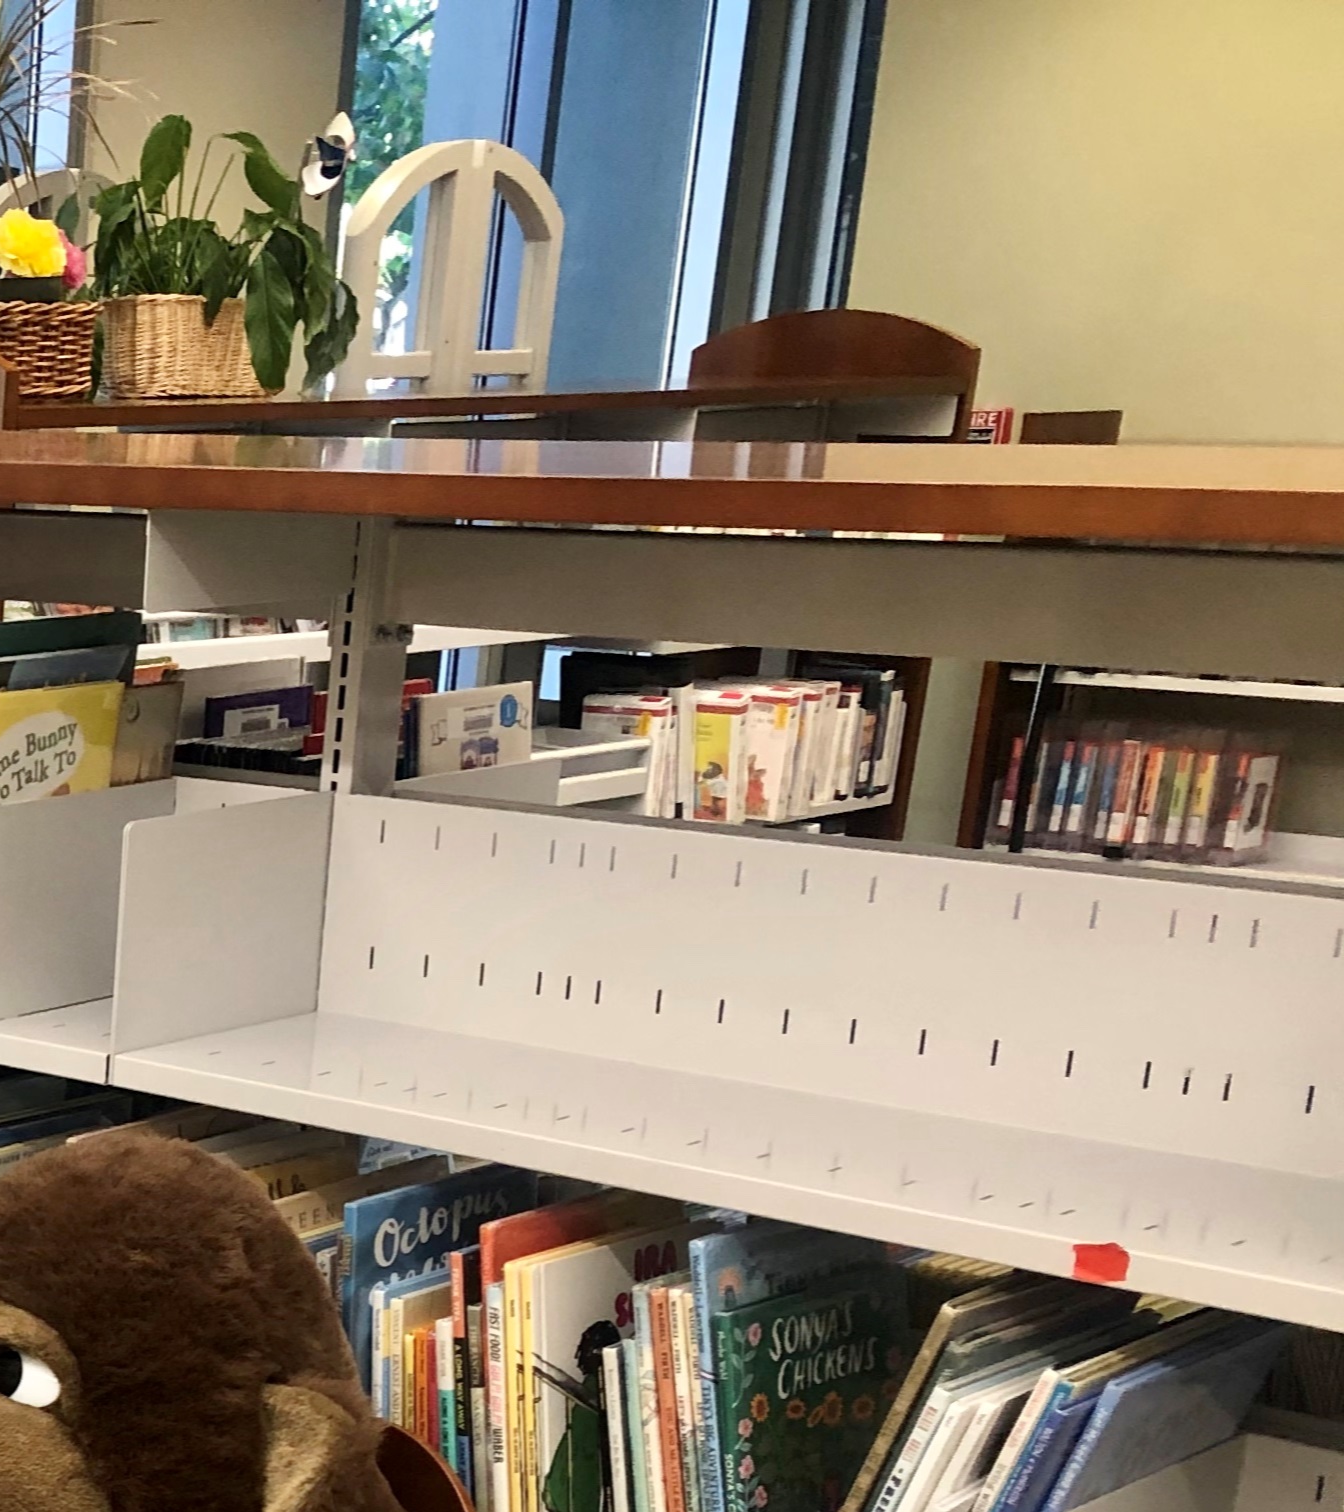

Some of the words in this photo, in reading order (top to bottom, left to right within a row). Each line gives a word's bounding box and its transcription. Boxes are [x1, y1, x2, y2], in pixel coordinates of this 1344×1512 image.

[25, 722, 78, 757] Bunny
[11, 760, 49, 792] Talk
[54, 750, 77, 775] To
[374, 1189, 508, 1268] Octopus
[634, 1240, 677, 1282] IRA
[488, 1306, 501, 1331] FAST
[768, 1303, 854, 1363] SONYA'S
[453, 1353, 463, 1379] LONG
[489, 1333, 501, 1362] FOOD!
[778, 1337, 877, 1399] CHICKENS
[455, 1382, 464, 1401] WAY
[456, 1404, 465, 1429] AWAY
[723, 1453, 736, 1499] SONYA'S
